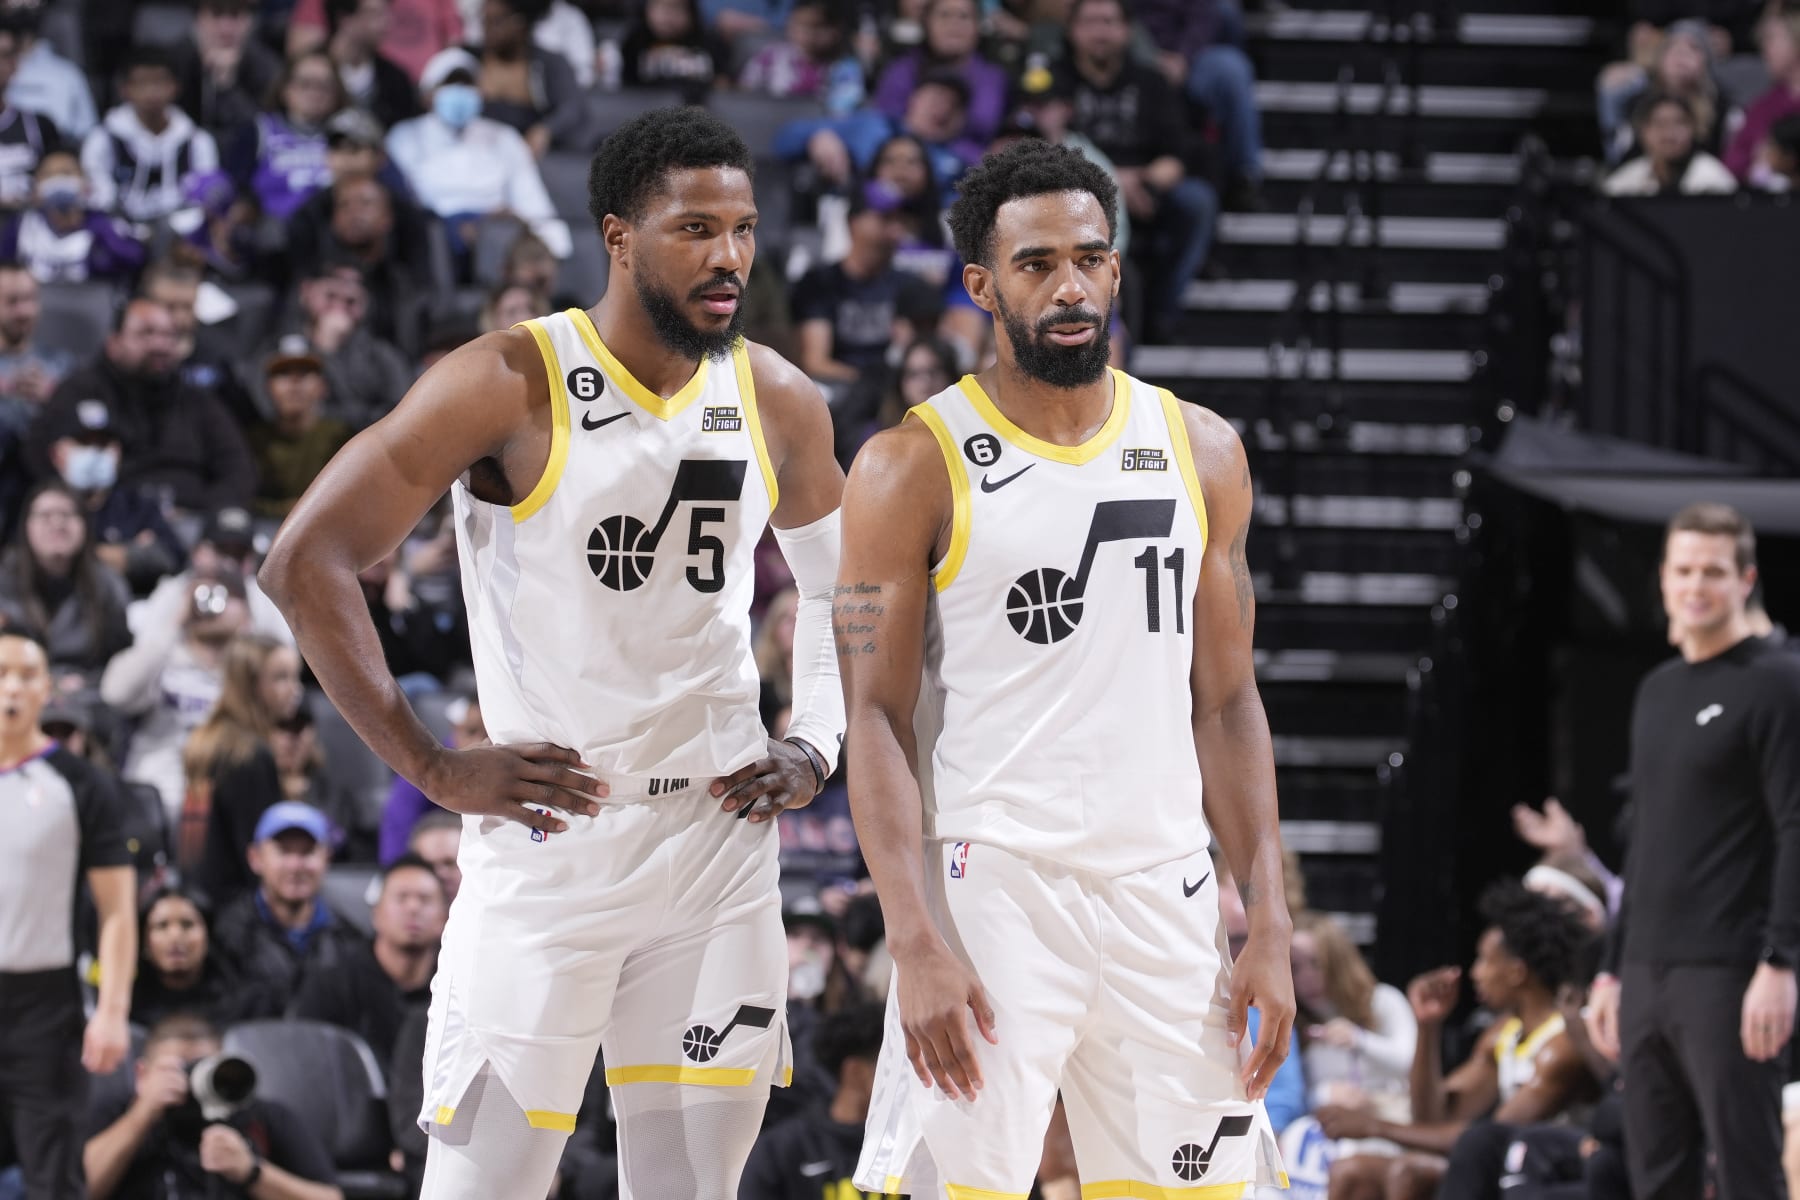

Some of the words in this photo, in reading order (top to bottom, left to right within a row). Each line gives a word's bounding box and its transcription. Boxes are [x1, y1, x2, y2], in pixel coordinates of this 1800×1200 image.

[576, 372, 595, 397] 6
[703, 409, 713, 430] 5
[716, 419, 740, 430] FIGHT
[971, 438, 994, 462] 6
[1124, 450, 1135, 470] 5
[1139, 459, 1166, 470] FIGHT
[686, 507, 725, 593] 5
[855, 582, 882, 594] them
[1134, 545, 1185, 635] 11
[859, 602, 885, 617] they
[847, 622, 876, 634] know
